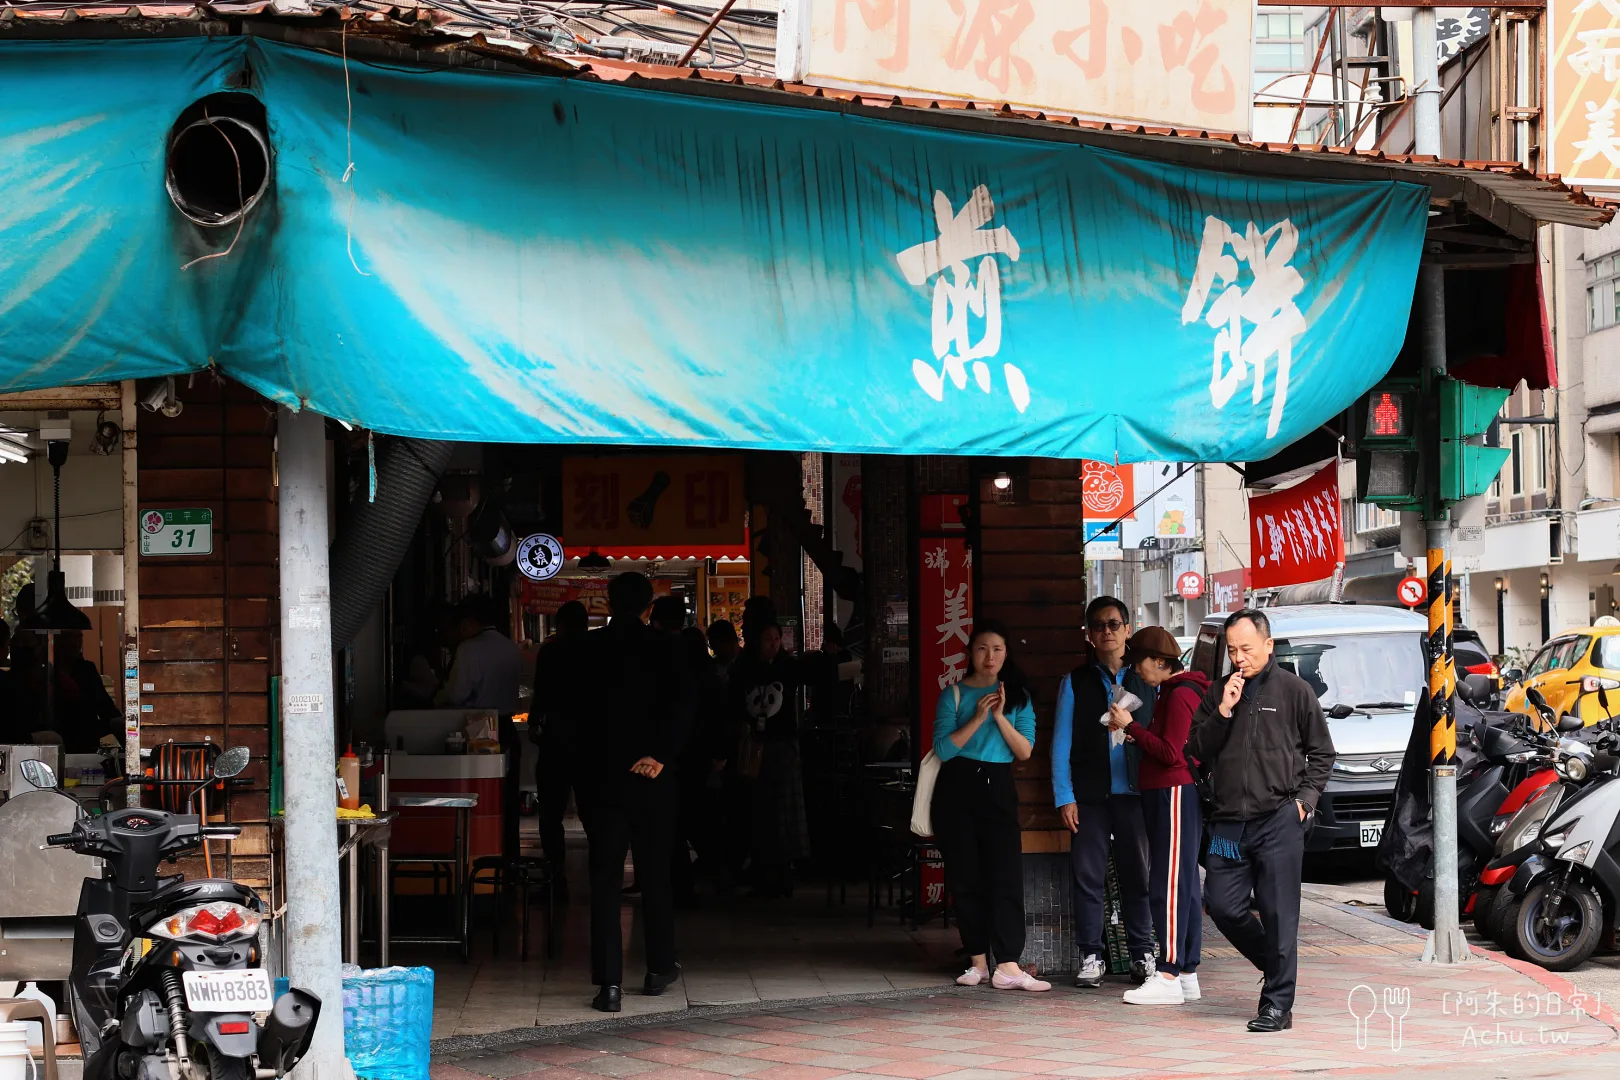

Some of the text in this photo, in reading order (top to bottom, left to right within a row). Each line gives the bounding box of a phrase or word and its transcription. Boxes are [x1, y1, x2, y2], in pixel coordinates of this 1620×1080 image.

[573, 470, 731, 530] 刻印
[165, 511, 210, 522] 四平街
[171, 528, 196, 548] 31
[525, 537, 550, 549] SKA
[1144, 538, 1156, 547] 2F
[521, 551, 560, 576] COFFEE
[1182, 575, 1199, 588] 10
